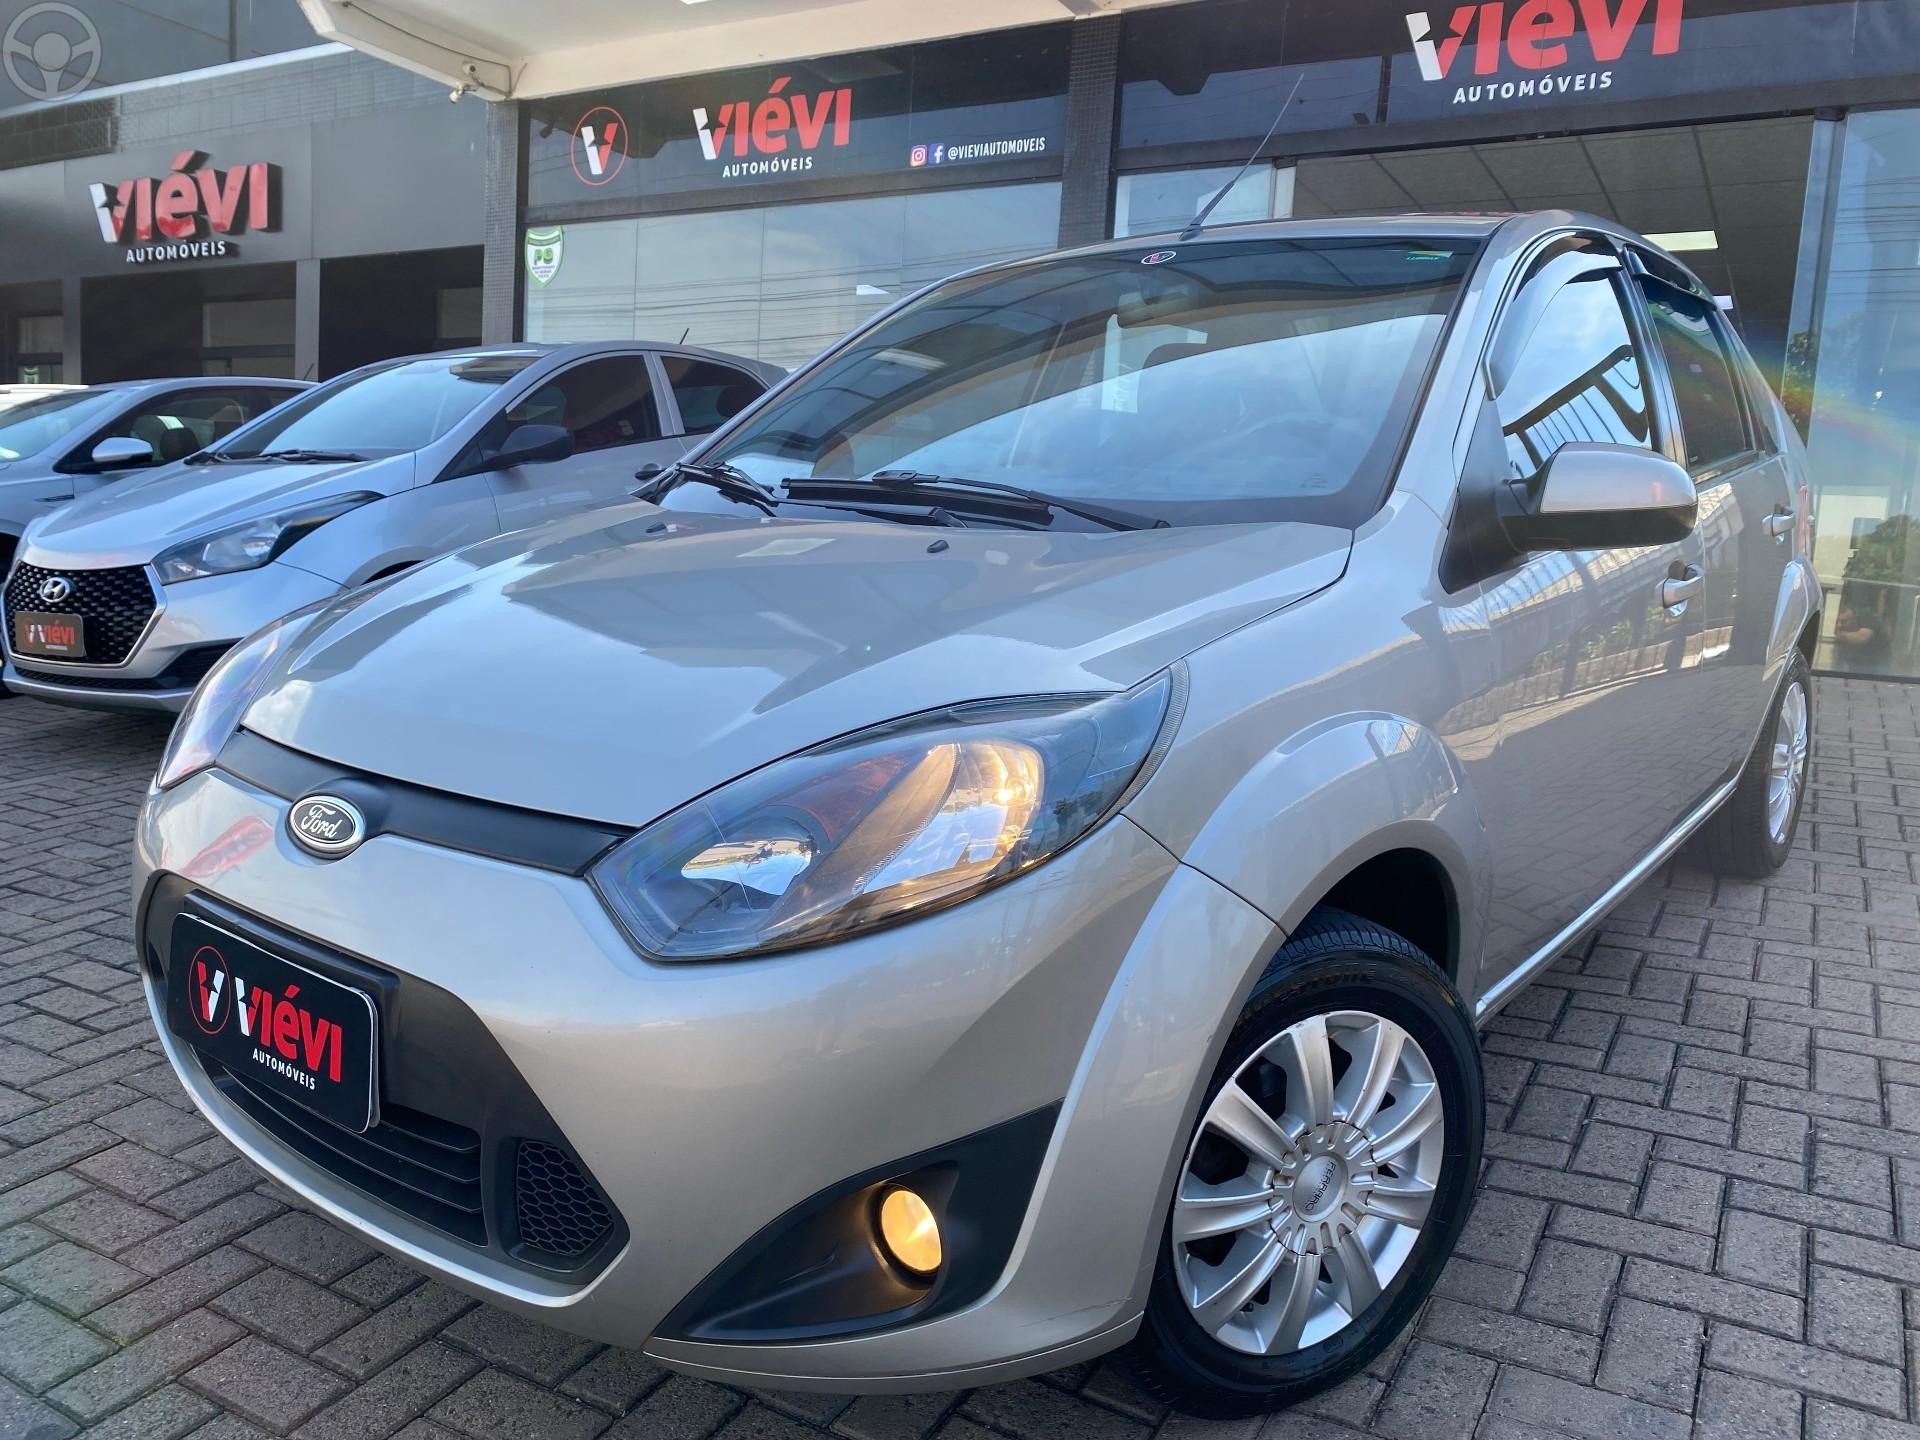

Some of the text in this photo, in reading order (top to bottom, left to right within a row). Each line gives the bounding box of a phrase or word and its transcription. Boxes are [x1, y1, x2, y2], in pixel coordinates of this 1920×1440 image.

[1453, 71, 1613, 104] AUTOMÓVEIS
[948, 137, 1046, 160] @VIEVIAUTOMOVEIS
[722, 156, 813, 178] AUTOMÓVEIS
[126, 240, 226, 263] AUTOMÓVEIS
[301, 805, 342, 838] Ford
[252, 1047, 316, 1091] AUTOMÓVEIS
